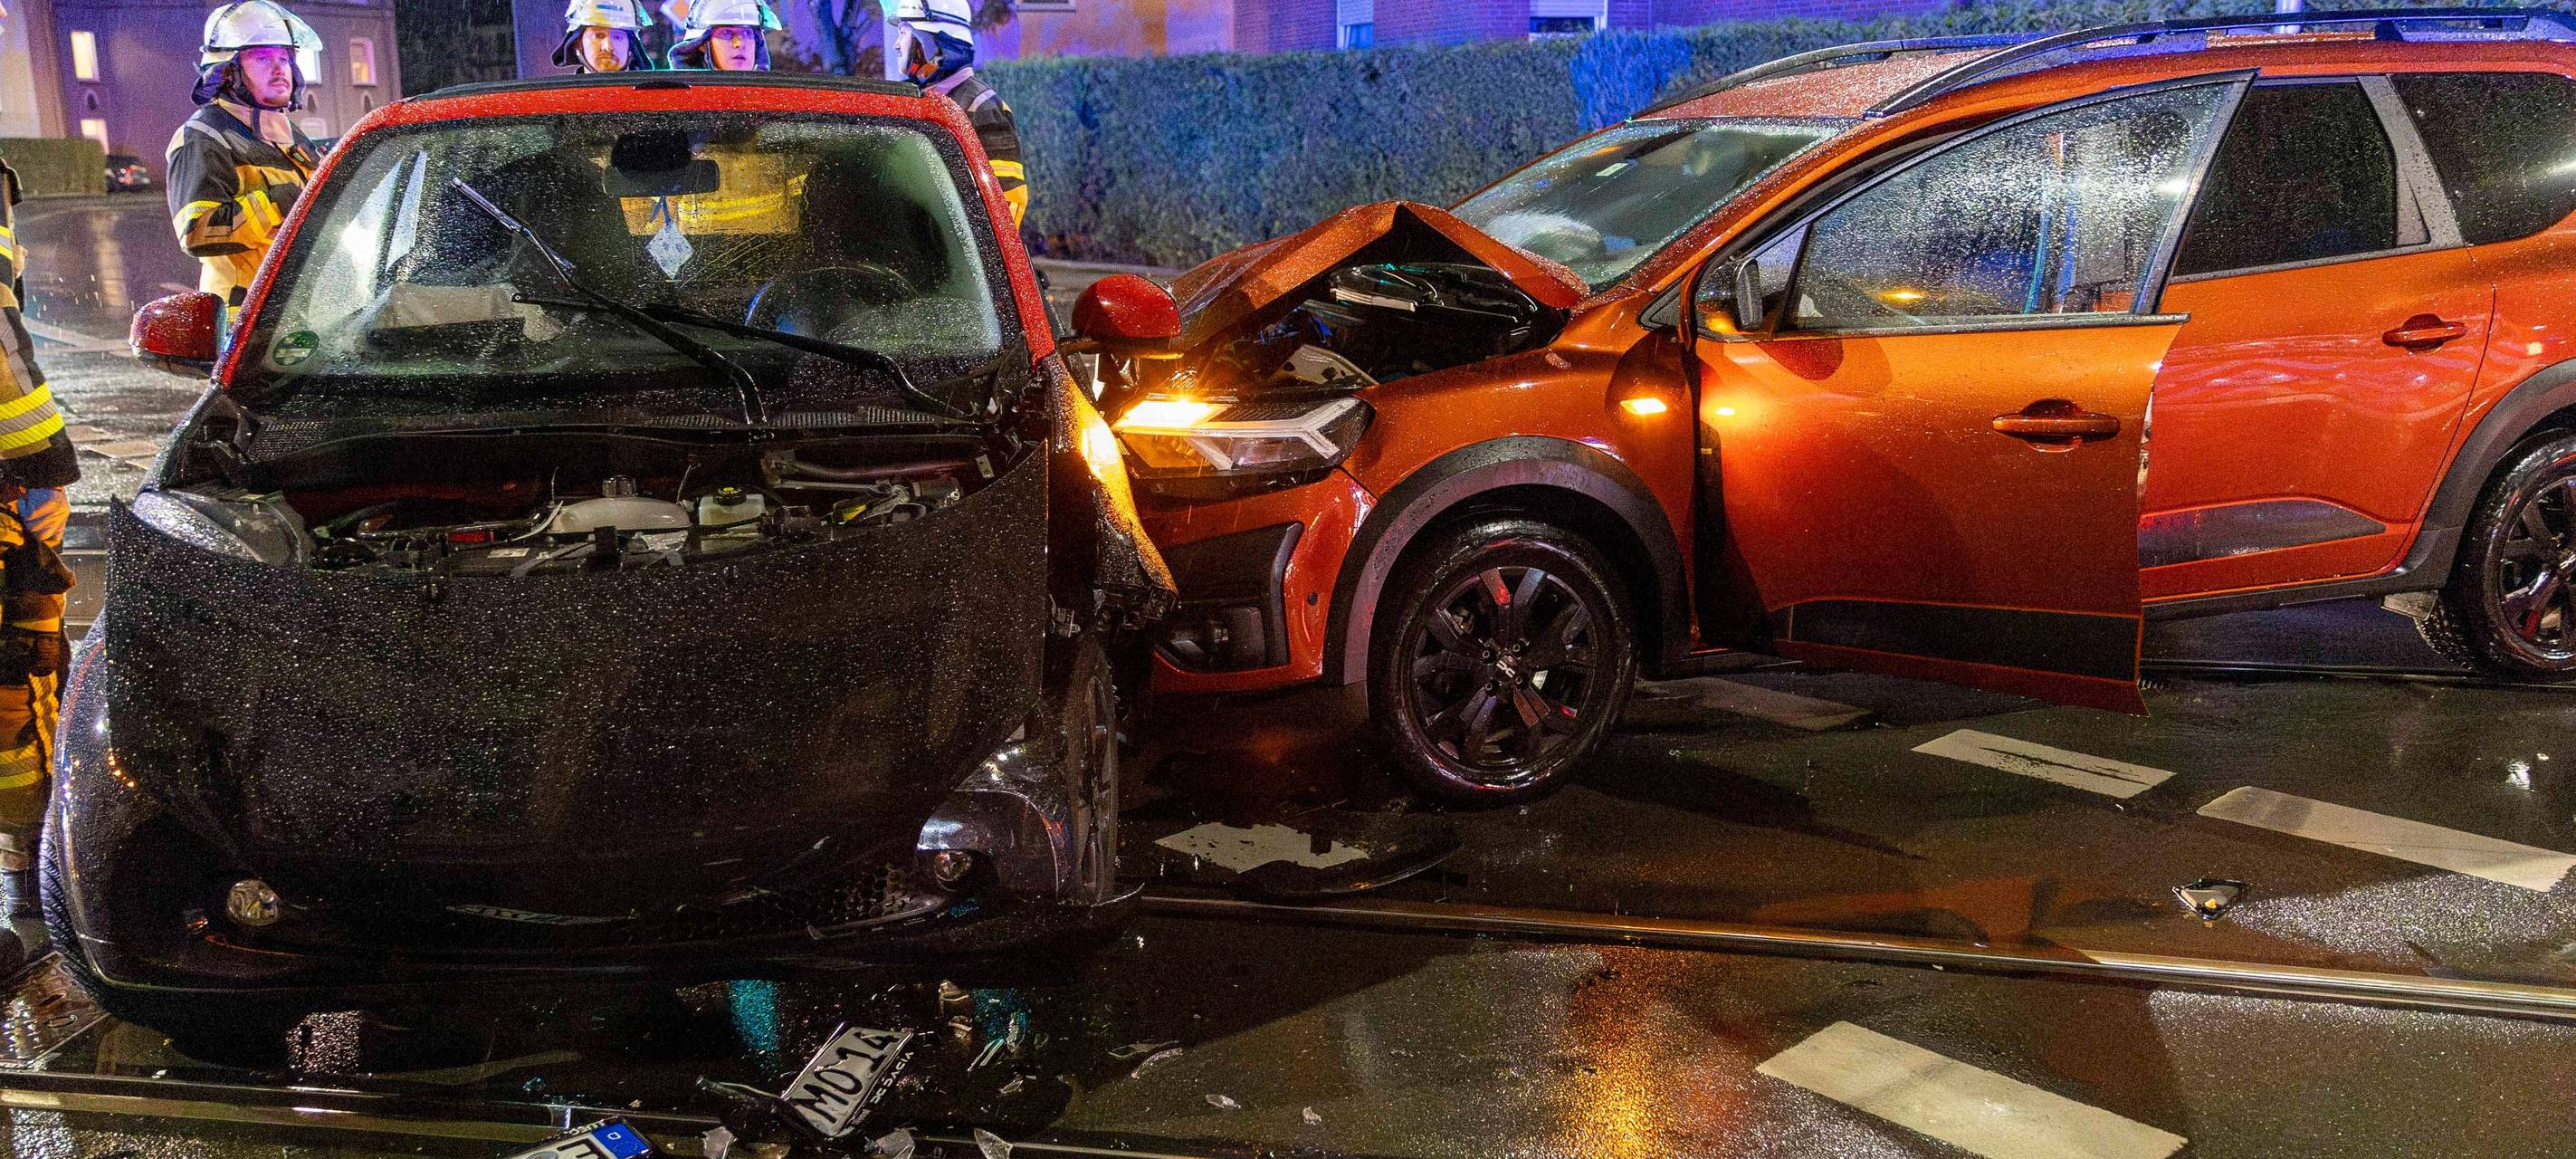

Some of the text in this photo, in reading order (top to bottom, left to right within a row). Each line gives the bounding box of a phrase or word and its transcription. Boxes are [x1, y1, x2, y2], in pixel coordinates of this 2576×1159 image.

[882, 1051, 915, 1088] DACIA
[790, 1068, 863, 1125] MO
[606, 1131, 622, 1141] D
